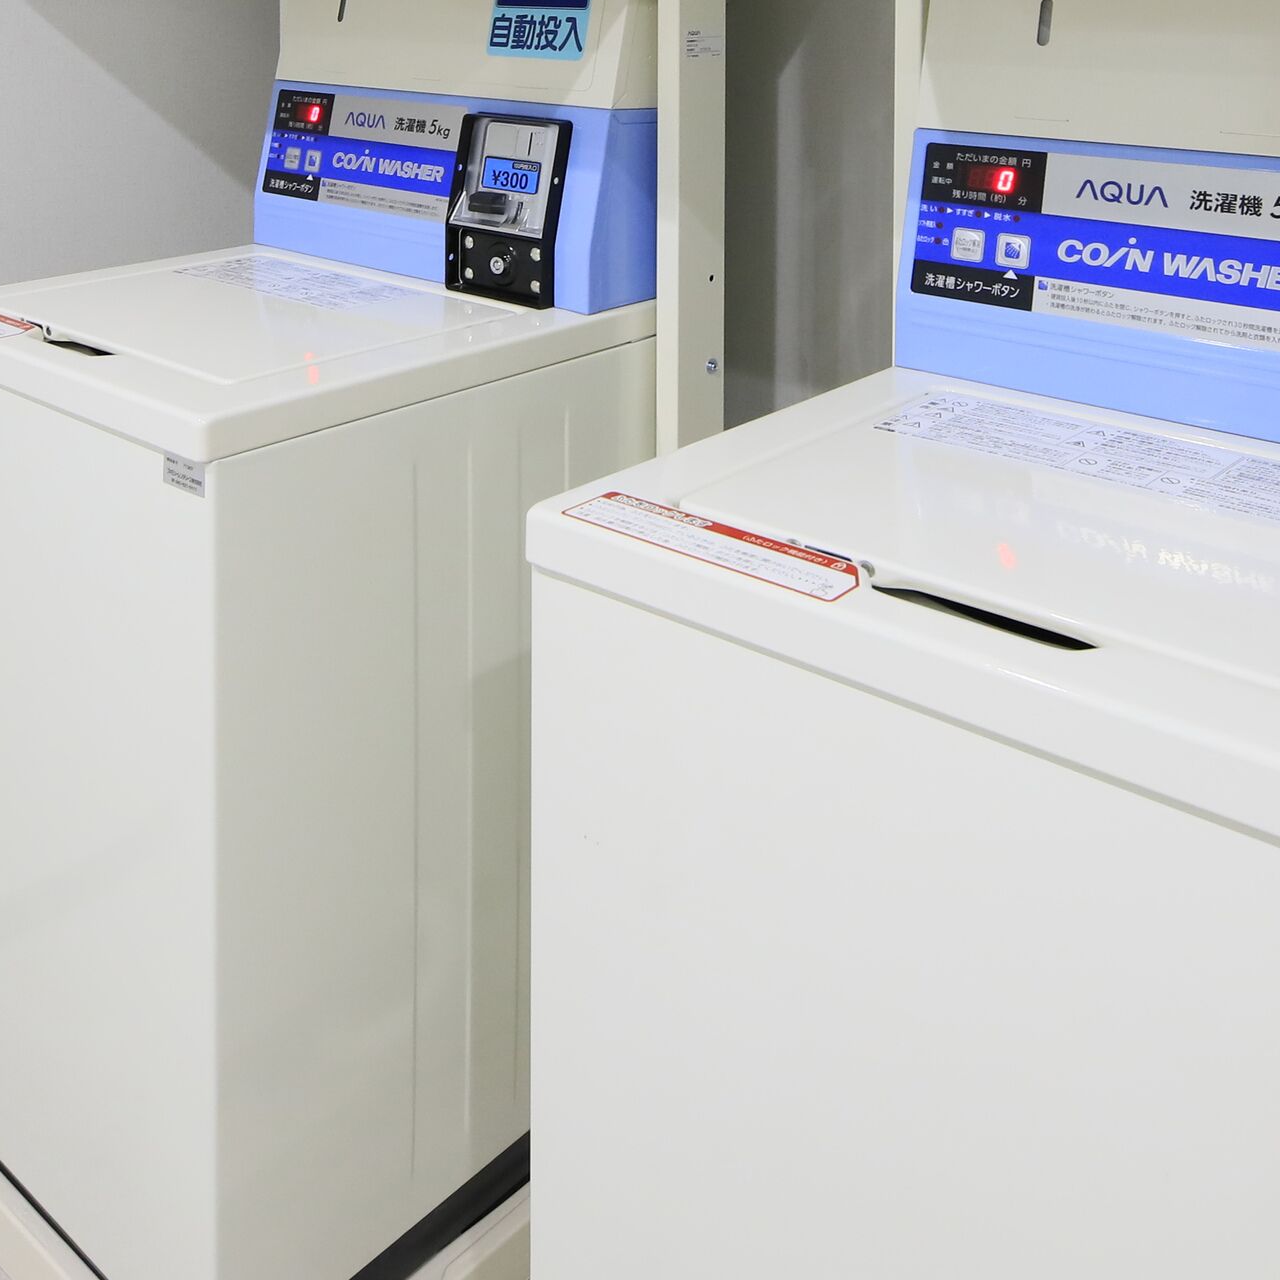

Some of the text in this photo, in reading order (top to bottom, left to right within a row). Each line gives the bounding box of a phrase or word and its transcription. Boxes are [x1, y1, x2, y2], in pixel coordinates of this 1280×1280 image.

[489, 12, 584, 53] 自動投入
[310, 106, 320, 122] 0
[344, 111, 386, 130] AQUA
[394, 116, 451, 140] 洗濯機 5kg
[378, 157, 445, 183] WASHER
[956, 152, 1032, 169] ただいまの金額 円
[491, 169, 529, 190] ¥300
[996, 170, 1015, 191] 0
[1018, 196, 1028, 206] 分
[1075, 178, 1169, 210] AQUA
[1189, 188, 1265, 217] 洗濯機
[924, 272, 1020, 298] 洗濯槽シャワーボタン
